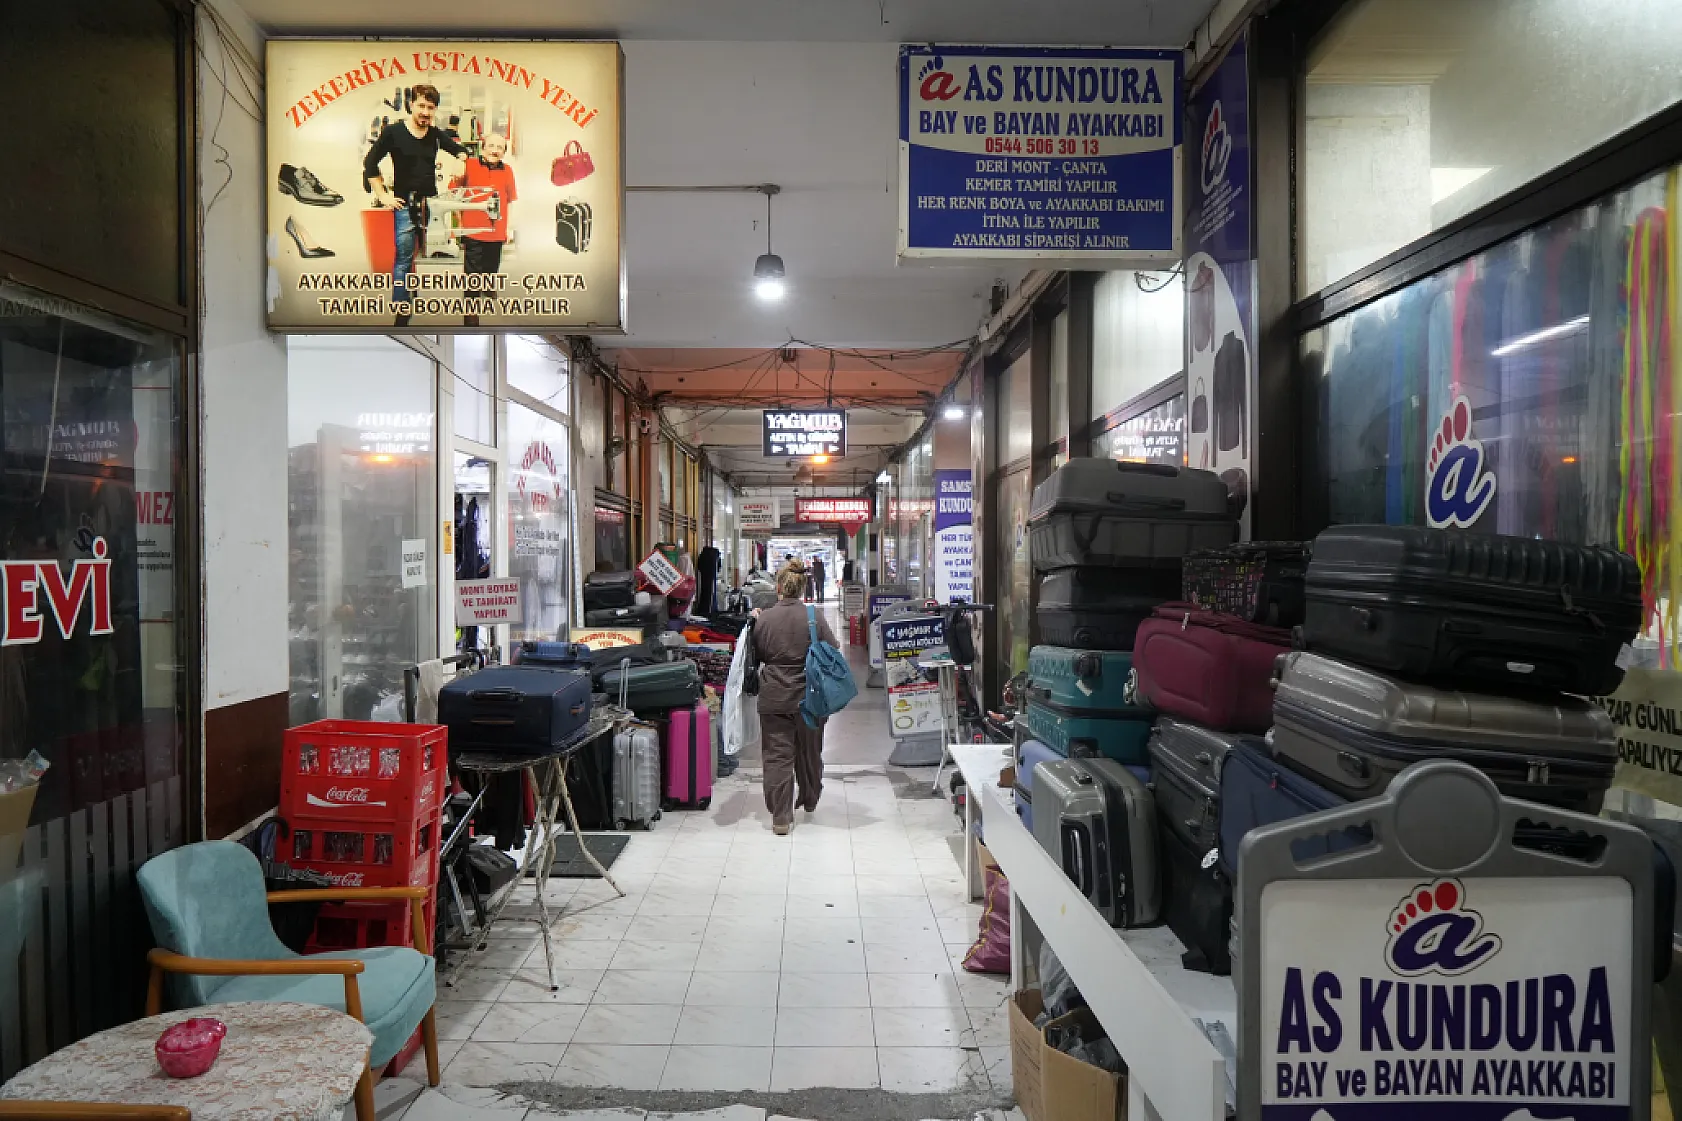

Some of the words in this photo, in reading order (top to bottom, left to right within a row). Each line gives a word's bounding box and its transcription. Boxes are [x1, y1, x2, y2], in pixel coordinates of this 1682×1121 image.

[284, 56, 407, 128] ZEKERİYA
[412, 51, 536, 90] USTA'NIN
[539, 77, 600, 129] YERİ
[963, 64, 1003, 101] AS
[1013, 65, 1163, 104] KUNDURA
[919, 110, 958, 134] BAY
[963, 114, 986, 134] ve
[993, 112, 1060, 136] BAYAN
[1066, 112, 1163, 137] AYAKKABI
[985, 136, 1022, 155] 0544
[1027, 137, 1053, 155] 506
[1059, 138, 1077, 156] 30
[1082, 138, 1099, 156] 13
[975, 158, 1009, 173] DERİ
[1012, 160, 1052, 174] MONT
[1062, 161, 1107, 177] ÇANTA
[965, 178, 1013, 192] KEMER
[1015, 177, 1062, 193] TAMİRİ
[1066, 180, 1117, 193] YAPILIR
[917, 195, 946, 210] HER
[949, 196, 987, 210] RENK
[990, 197, 1026, 210] BOYA
[1028, 200, 1043, 211] ve
[1046, 198, 1114, 212] AYAKKABI
[1116, 199, 1165, 213] BAKIMI
[1024, 213, 1045, 229] İLE
[1048, 215, 1101, 230] YAPILIR
[953, 233, 1022, 247] AYAKKABI
[1084, 234, 1130, 248] ALINIR
[298, 273, 392, 291] AYAKKABI
[405, 270, 508, 291] DERİMONT
[523, 273, 587, 294] ÇANTA
[319, 294, 384, 315] TAMİRİ
[389, 301, 410, 315] ve
[414, 298, 495, 315] BOYAMA
[495, 298, 571, 315] YAPILIR
[941, 480, 972, 493] SAMS
[135, 491, 173, 525] MEZ
[939, 497, 972, 514] KUNDU
[1590, 696, 1632, 728] ZAR
[1636, 701, 1682, 736] GÜNL
[1618, 736, 1682, 777] APALIYIZ
[1277, 966, 1343, 1054] AS
[1359, 966, 1616, 1054] KUNDURA
[1276, 1061, 1328, 1098] BAY
[1336, 1067, 1366, 1097] ve
[1374, 1058, 1463, 1096] BAYAN
[1471, 1059, 1616, 1099] AYAKKABI
